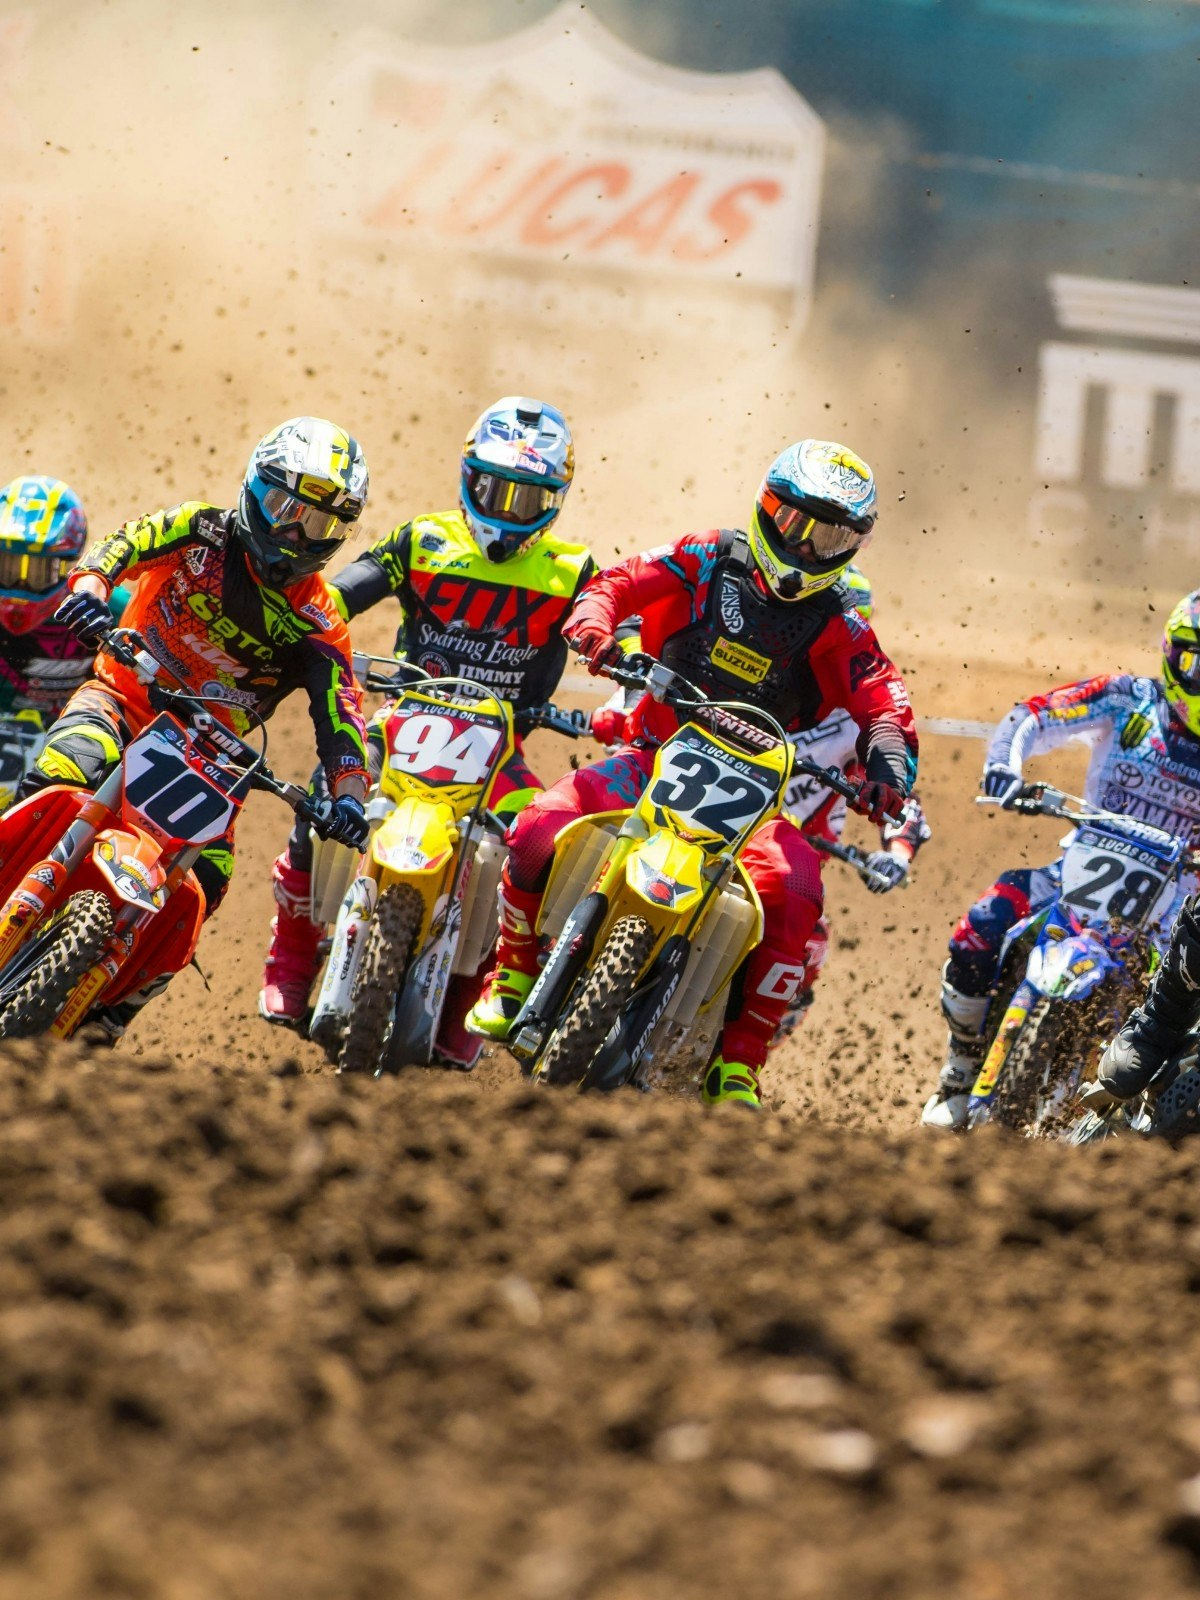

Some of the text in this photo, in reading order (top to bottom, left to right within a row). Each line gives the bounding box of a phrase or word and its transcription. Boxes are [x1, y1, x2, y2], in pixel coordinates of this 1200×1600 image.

[362, 138, 786, 264] LUCAS
[424, 572, 556, 649] FOX
[418, 623, 487, 661] Soaring
[484, 639, 539, 667] Eagle
[713, 648, 765, 679] SUZUKI
[457, 664, 526, 685] JIMMY
[423, 704, 477, 722] LUCAS OIL
[695, 706, 777, 750] RENTHA
[389, 714, 502, 785] 94
[700, 743, 754, 776] LUCAS OIL
[125, 747, 230, 841] 10
[205, 765, 224, 781] OIL
[650, 751, 767, 844] 32
[1096, 837, 1159, 869] LUCAS OIL
[1062, 855, 1162, 925] 28
[630, 972, 680, 1068] DUNLOP
